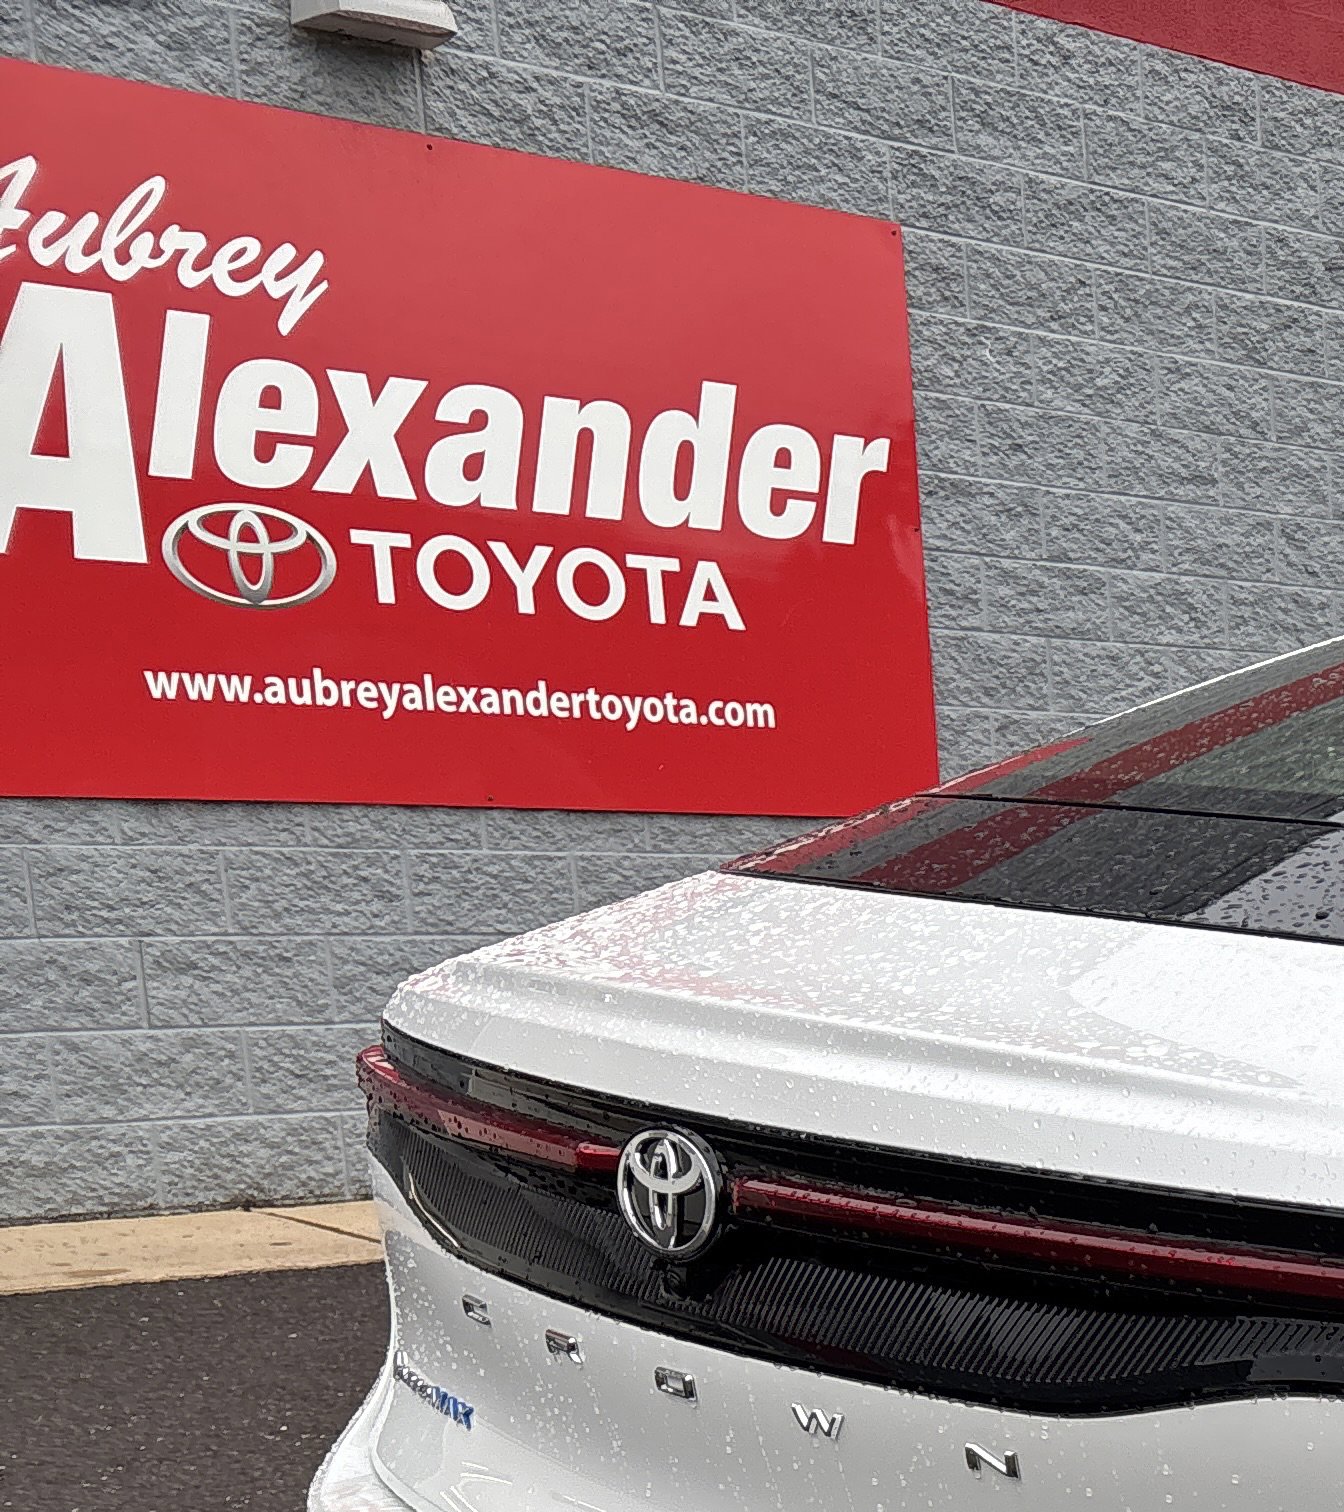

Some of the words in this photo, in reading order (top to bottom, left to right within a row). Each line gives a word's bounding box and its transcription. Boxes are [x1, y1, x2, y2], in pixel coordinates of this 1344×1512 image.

[0, 281, 892, 564] Alexander
[349, 528, 747, 632] TOYOTA
[143, 667, 777, 732] www.aubreyalexandertoyota.com
